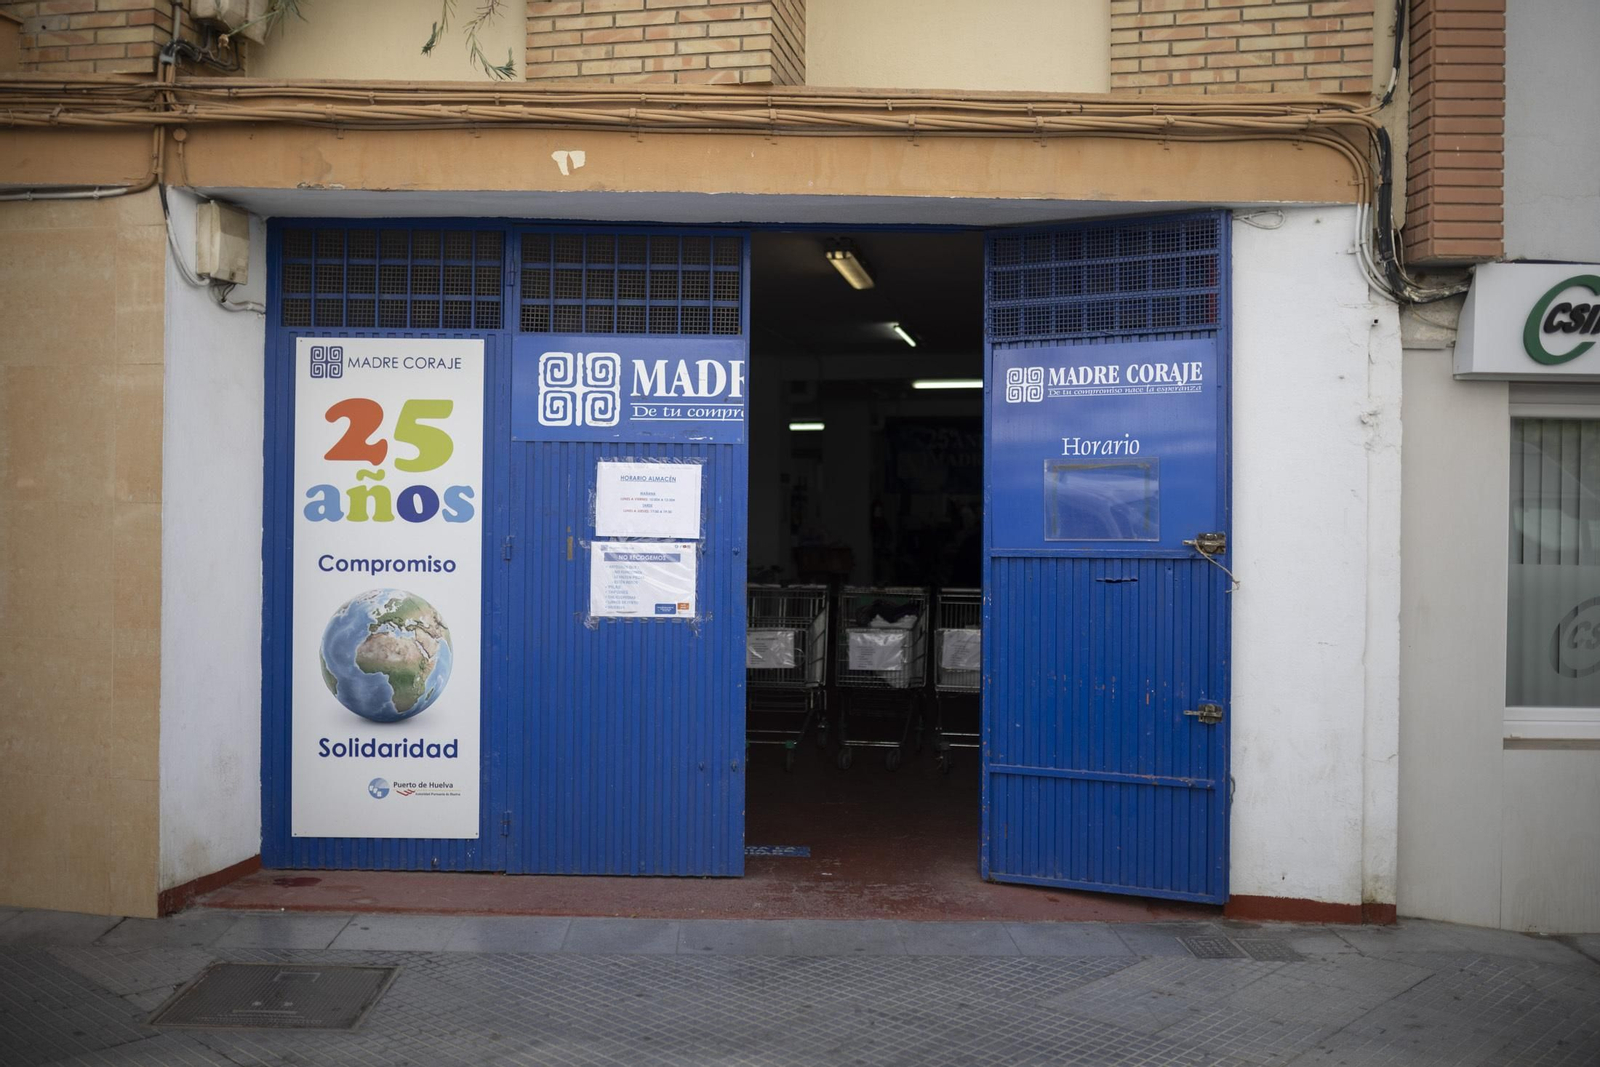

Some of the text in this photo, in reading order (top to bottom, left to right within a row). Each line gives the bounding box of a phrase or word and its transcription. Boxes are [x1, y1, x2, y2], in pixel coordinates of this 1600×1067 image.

[347, 356, 462, 370] MADRE CORAJE
[1048, 362, 1203, 386] MADRE CORAJE
[1073, 387, 1124, 397] compromiso
[1156, 385, 1201, 393] esperanza
[632, 406, 744, 421] De tu compr
[324, 398, 454, 473] 25
[1061, 433, 1140, 456] Horario
[648, 475, 677, 483] ALMACÉN
[303, 469, 475, 523] años
[318, 554, 456, 576] Compromiso
[318, 737, 458, 759] Solidaridad
[429, 781, 454, 789] Huelva
